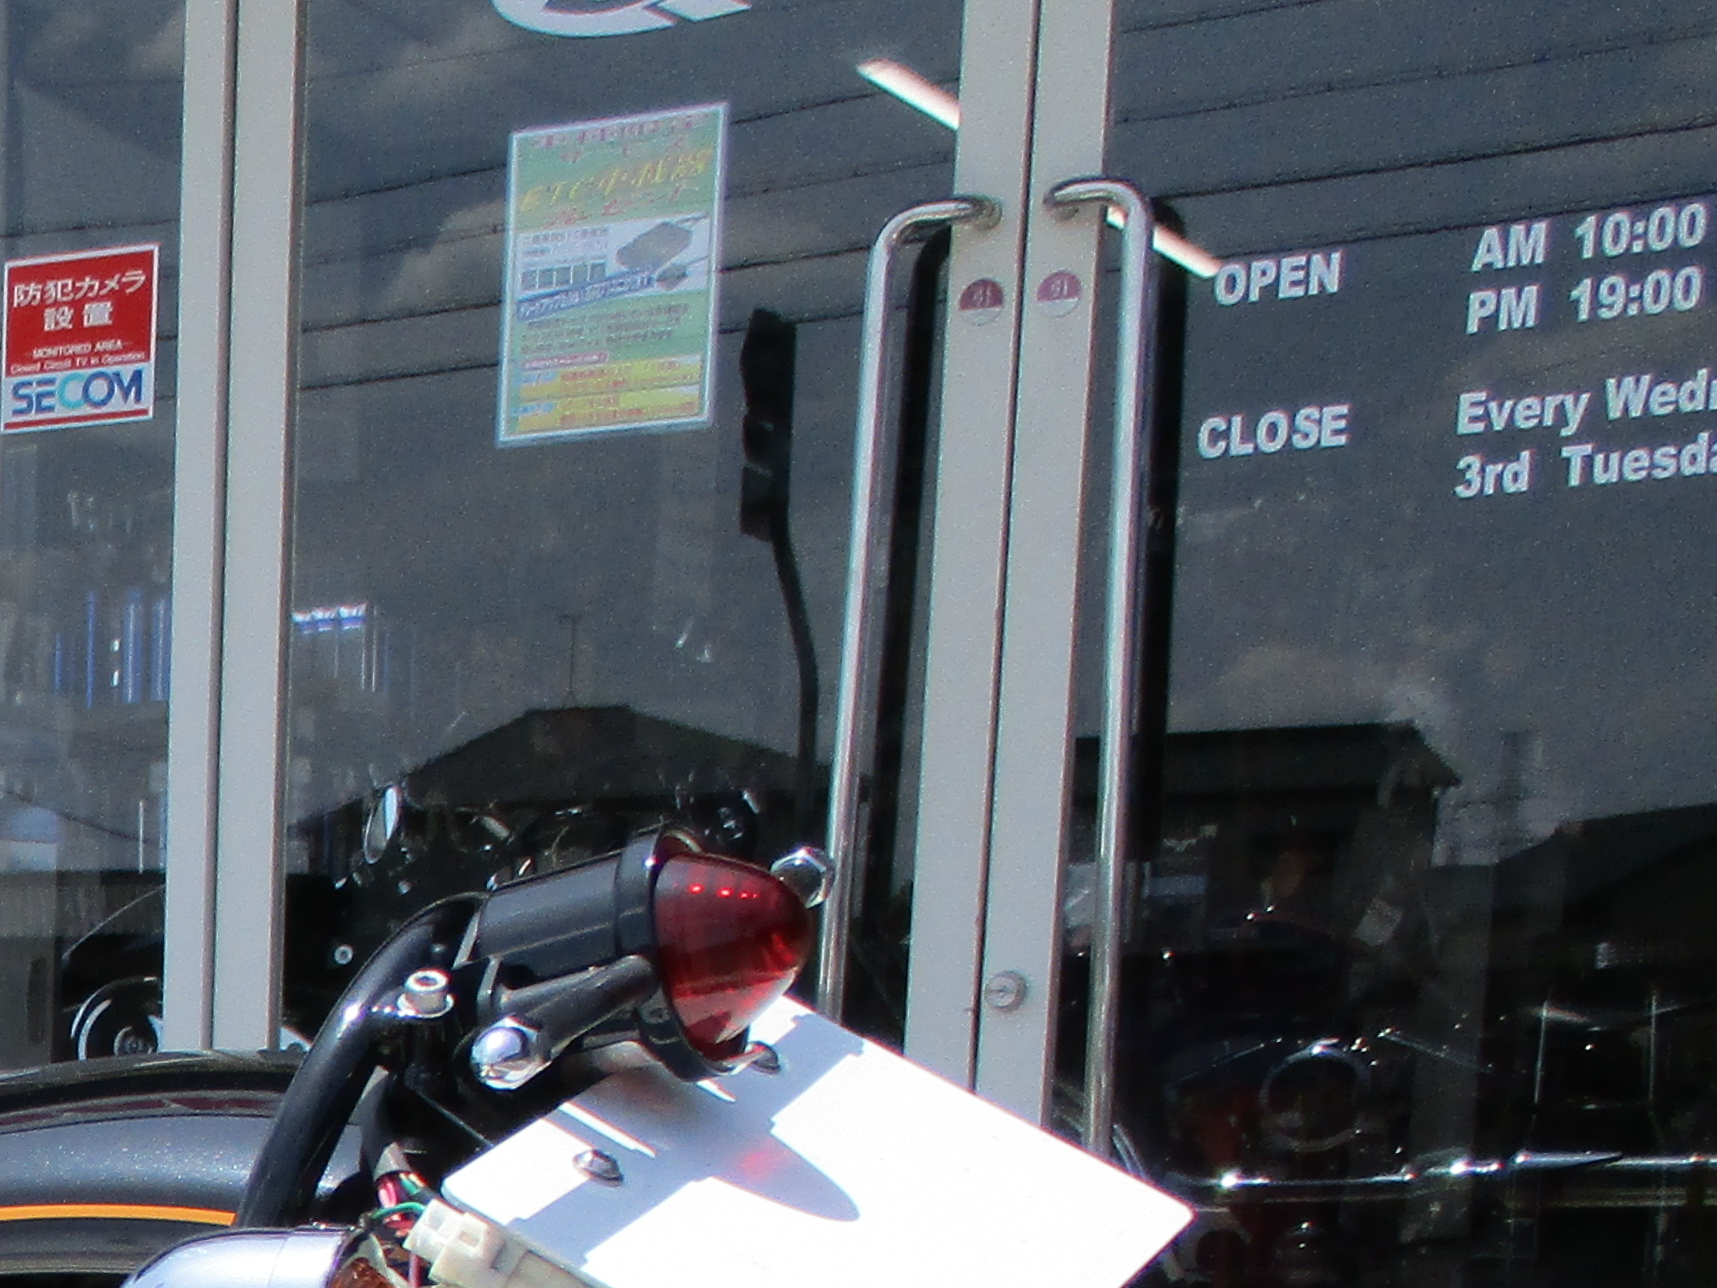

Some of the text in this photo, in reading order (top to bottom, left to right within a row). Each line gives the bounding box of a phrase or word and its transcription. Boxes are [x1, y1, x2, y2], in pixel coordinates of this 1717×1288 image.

[1471, 202, 1708, 272] AM 10:00
[13, 270, 147, 308] 防犯カメラ
[1214, 250, 1344, 305] OPEN
[1466, 266, 1704, 334] PM 19:00
[43, 301, 113, 332] 設置
[11, 367, 144, 416] SECOM
[1456, 388, 1591, 437] Every
[1197, 405, 1350, 459] CLOSE
[1454, 450, 1532, 499] 3rd
